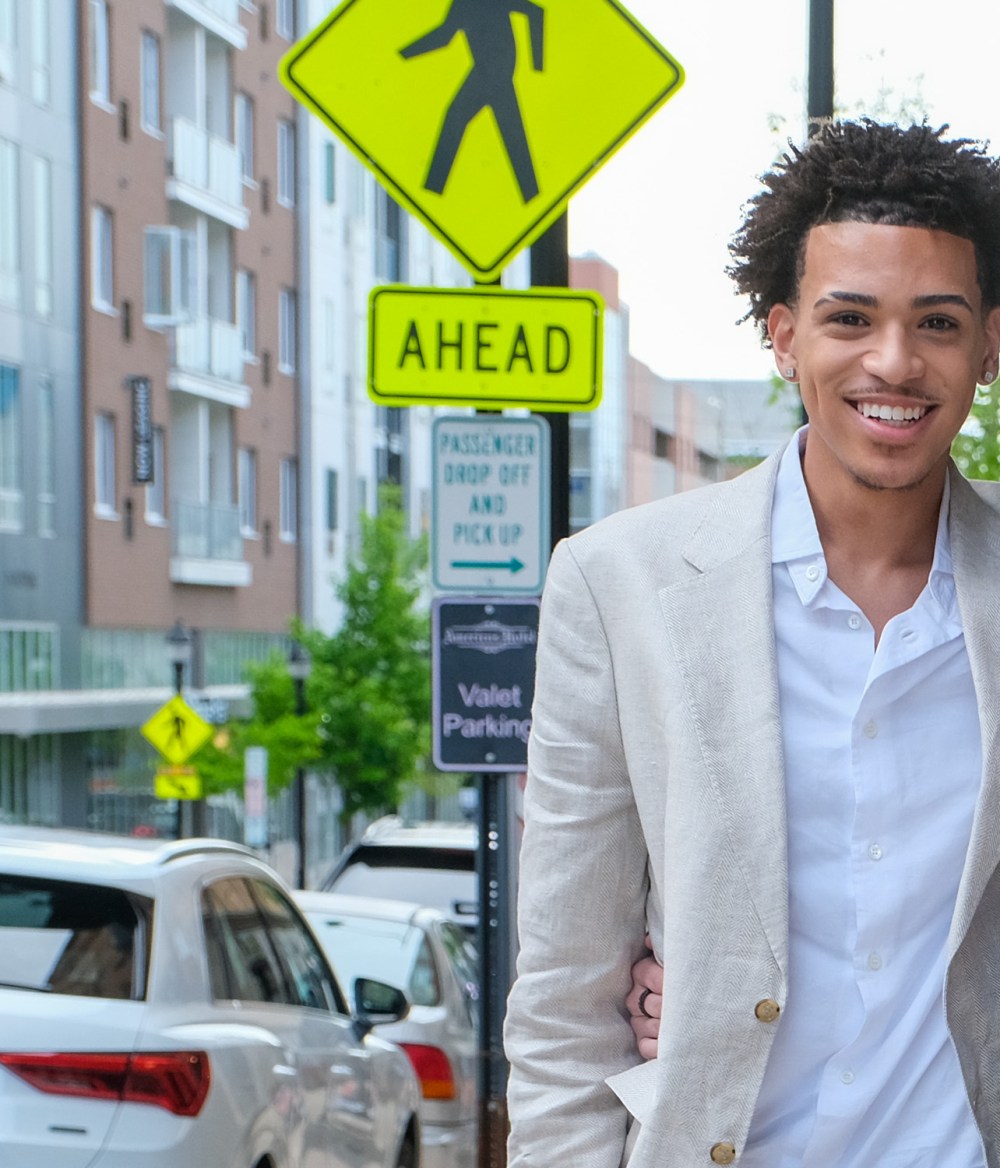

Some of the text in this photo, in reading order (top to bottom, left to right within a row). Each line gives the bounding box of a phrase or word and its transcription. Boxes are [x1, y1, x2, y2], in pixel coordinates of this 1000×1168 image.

[397, 321, 571, 374] AHEAD
[440, 433, 535, 456] PASSENGER
[444, 463, 531, 486] DROP OFF
[469, 493, 506, 515] AND
[453, 523, 523, 546] PICK UP
[458, 682, 523, 708] Valet
